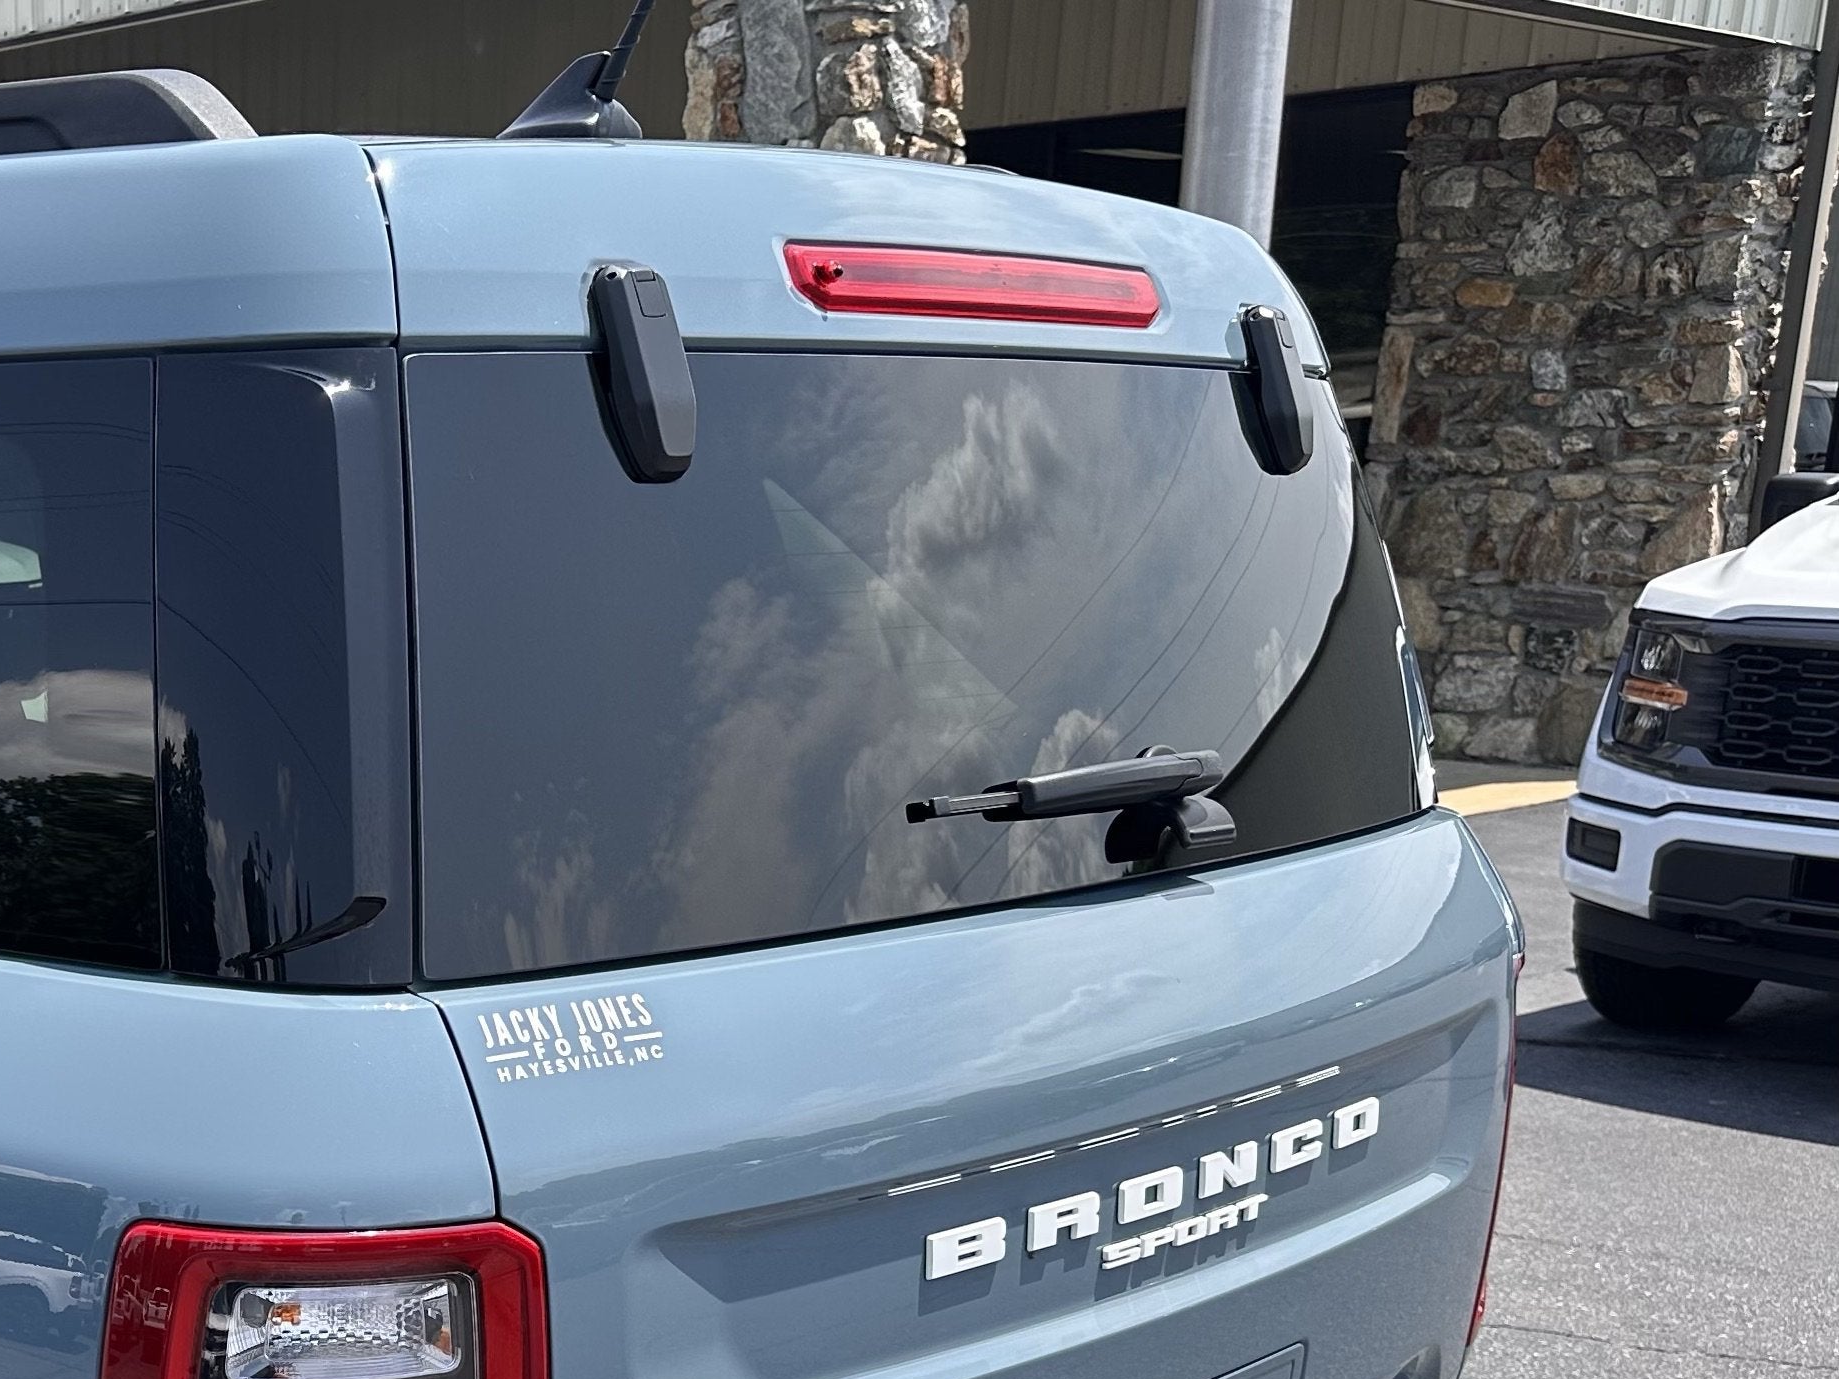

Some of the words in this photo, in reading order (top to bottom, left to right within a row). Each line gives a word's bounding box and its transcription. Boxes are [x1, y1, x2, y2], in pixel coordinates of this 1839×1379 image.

[477, 1004, 563, 1048] JACKY
[570, 993, 653, 1035] JONES
[532, 1031, 618, 1060] FORD
[925, 1096, 1380, 1281] BRONCO
[1101, 1193, 1269, 1270] SPORT
